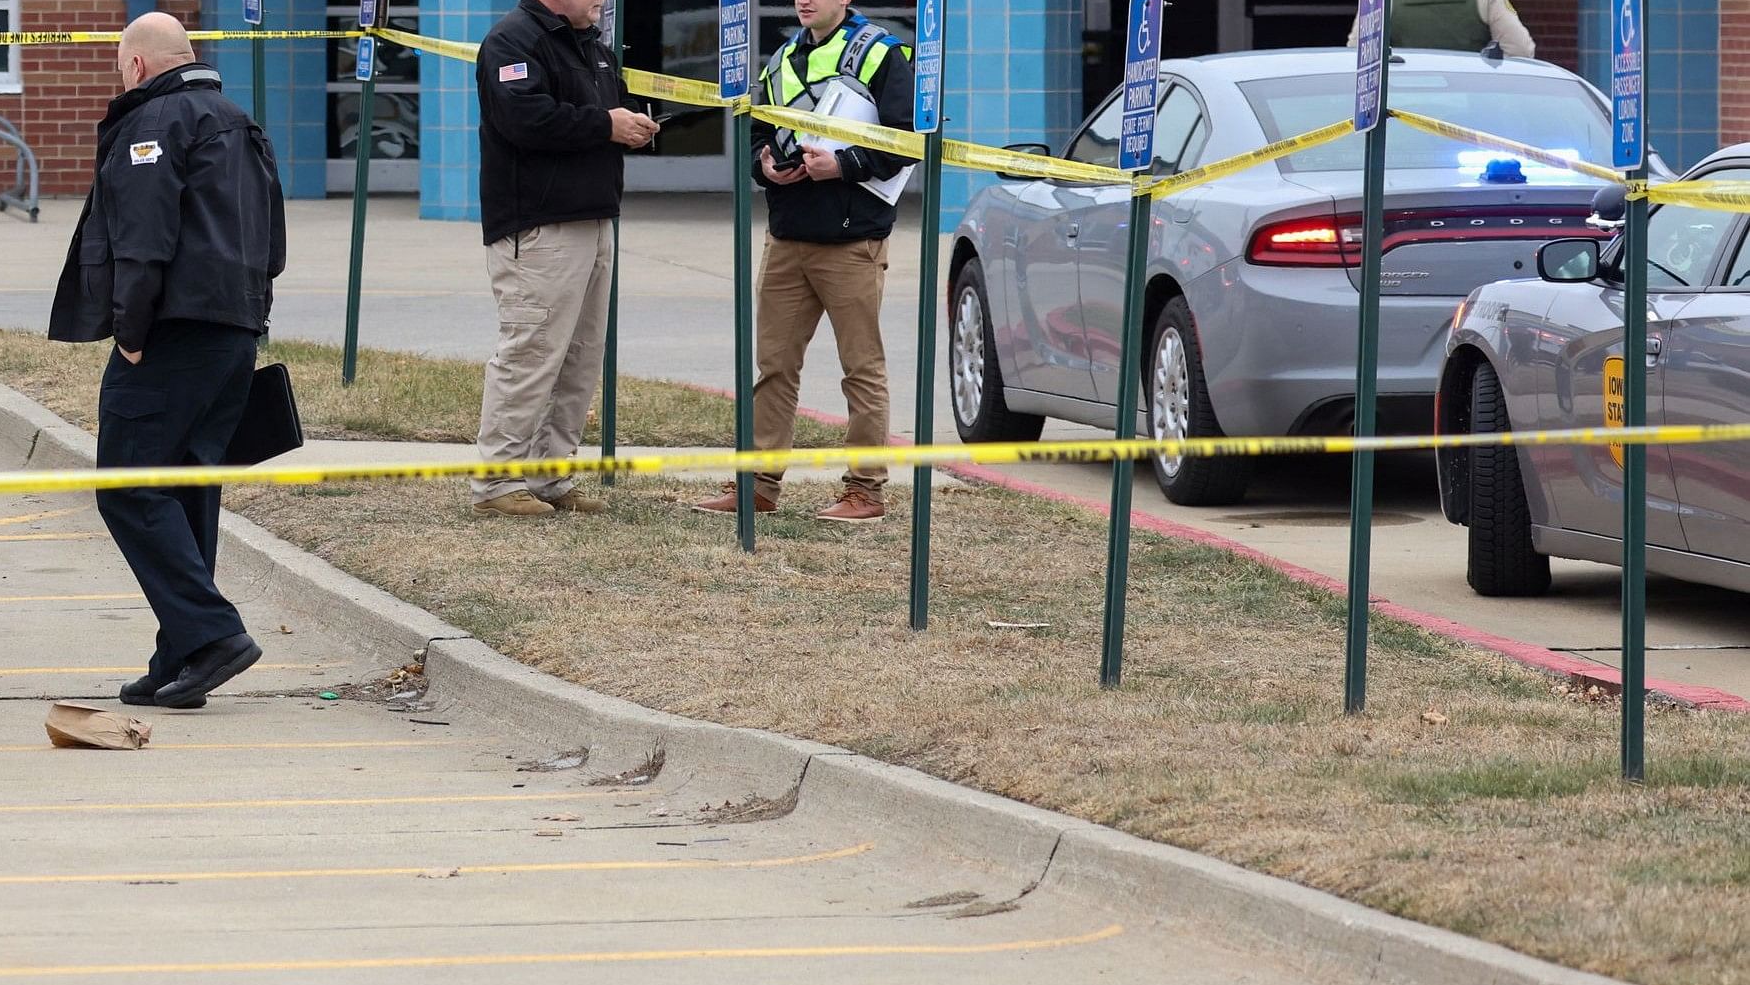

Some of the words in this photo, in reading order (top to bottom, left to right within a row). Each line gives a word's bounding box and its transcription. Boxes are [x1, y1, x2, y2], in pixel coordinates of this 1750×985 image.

[724, 24, 746, 45] PARKING
[844, 31, 872, 71] EMA
[1127, 58, 1156, 84] HANDICAPPED
[1128, 84, 1152, 109] PARKING
[1614, 75, 1640, 97] PASSENGER
[1618, 98, 1637, 120] LOADING
[1123, 117, 1137, 135] STATE
[1138, 114, 1154, 133] PERMIT
[1621, 123, 1634, 143] ZONE
[1125, 134, 1148, 153] REQUIRED
[1430, 218, 1564, 228] DODG
[1609, 376, 1624, 396] IOW
[1607, 402, 1624, 423] STA
